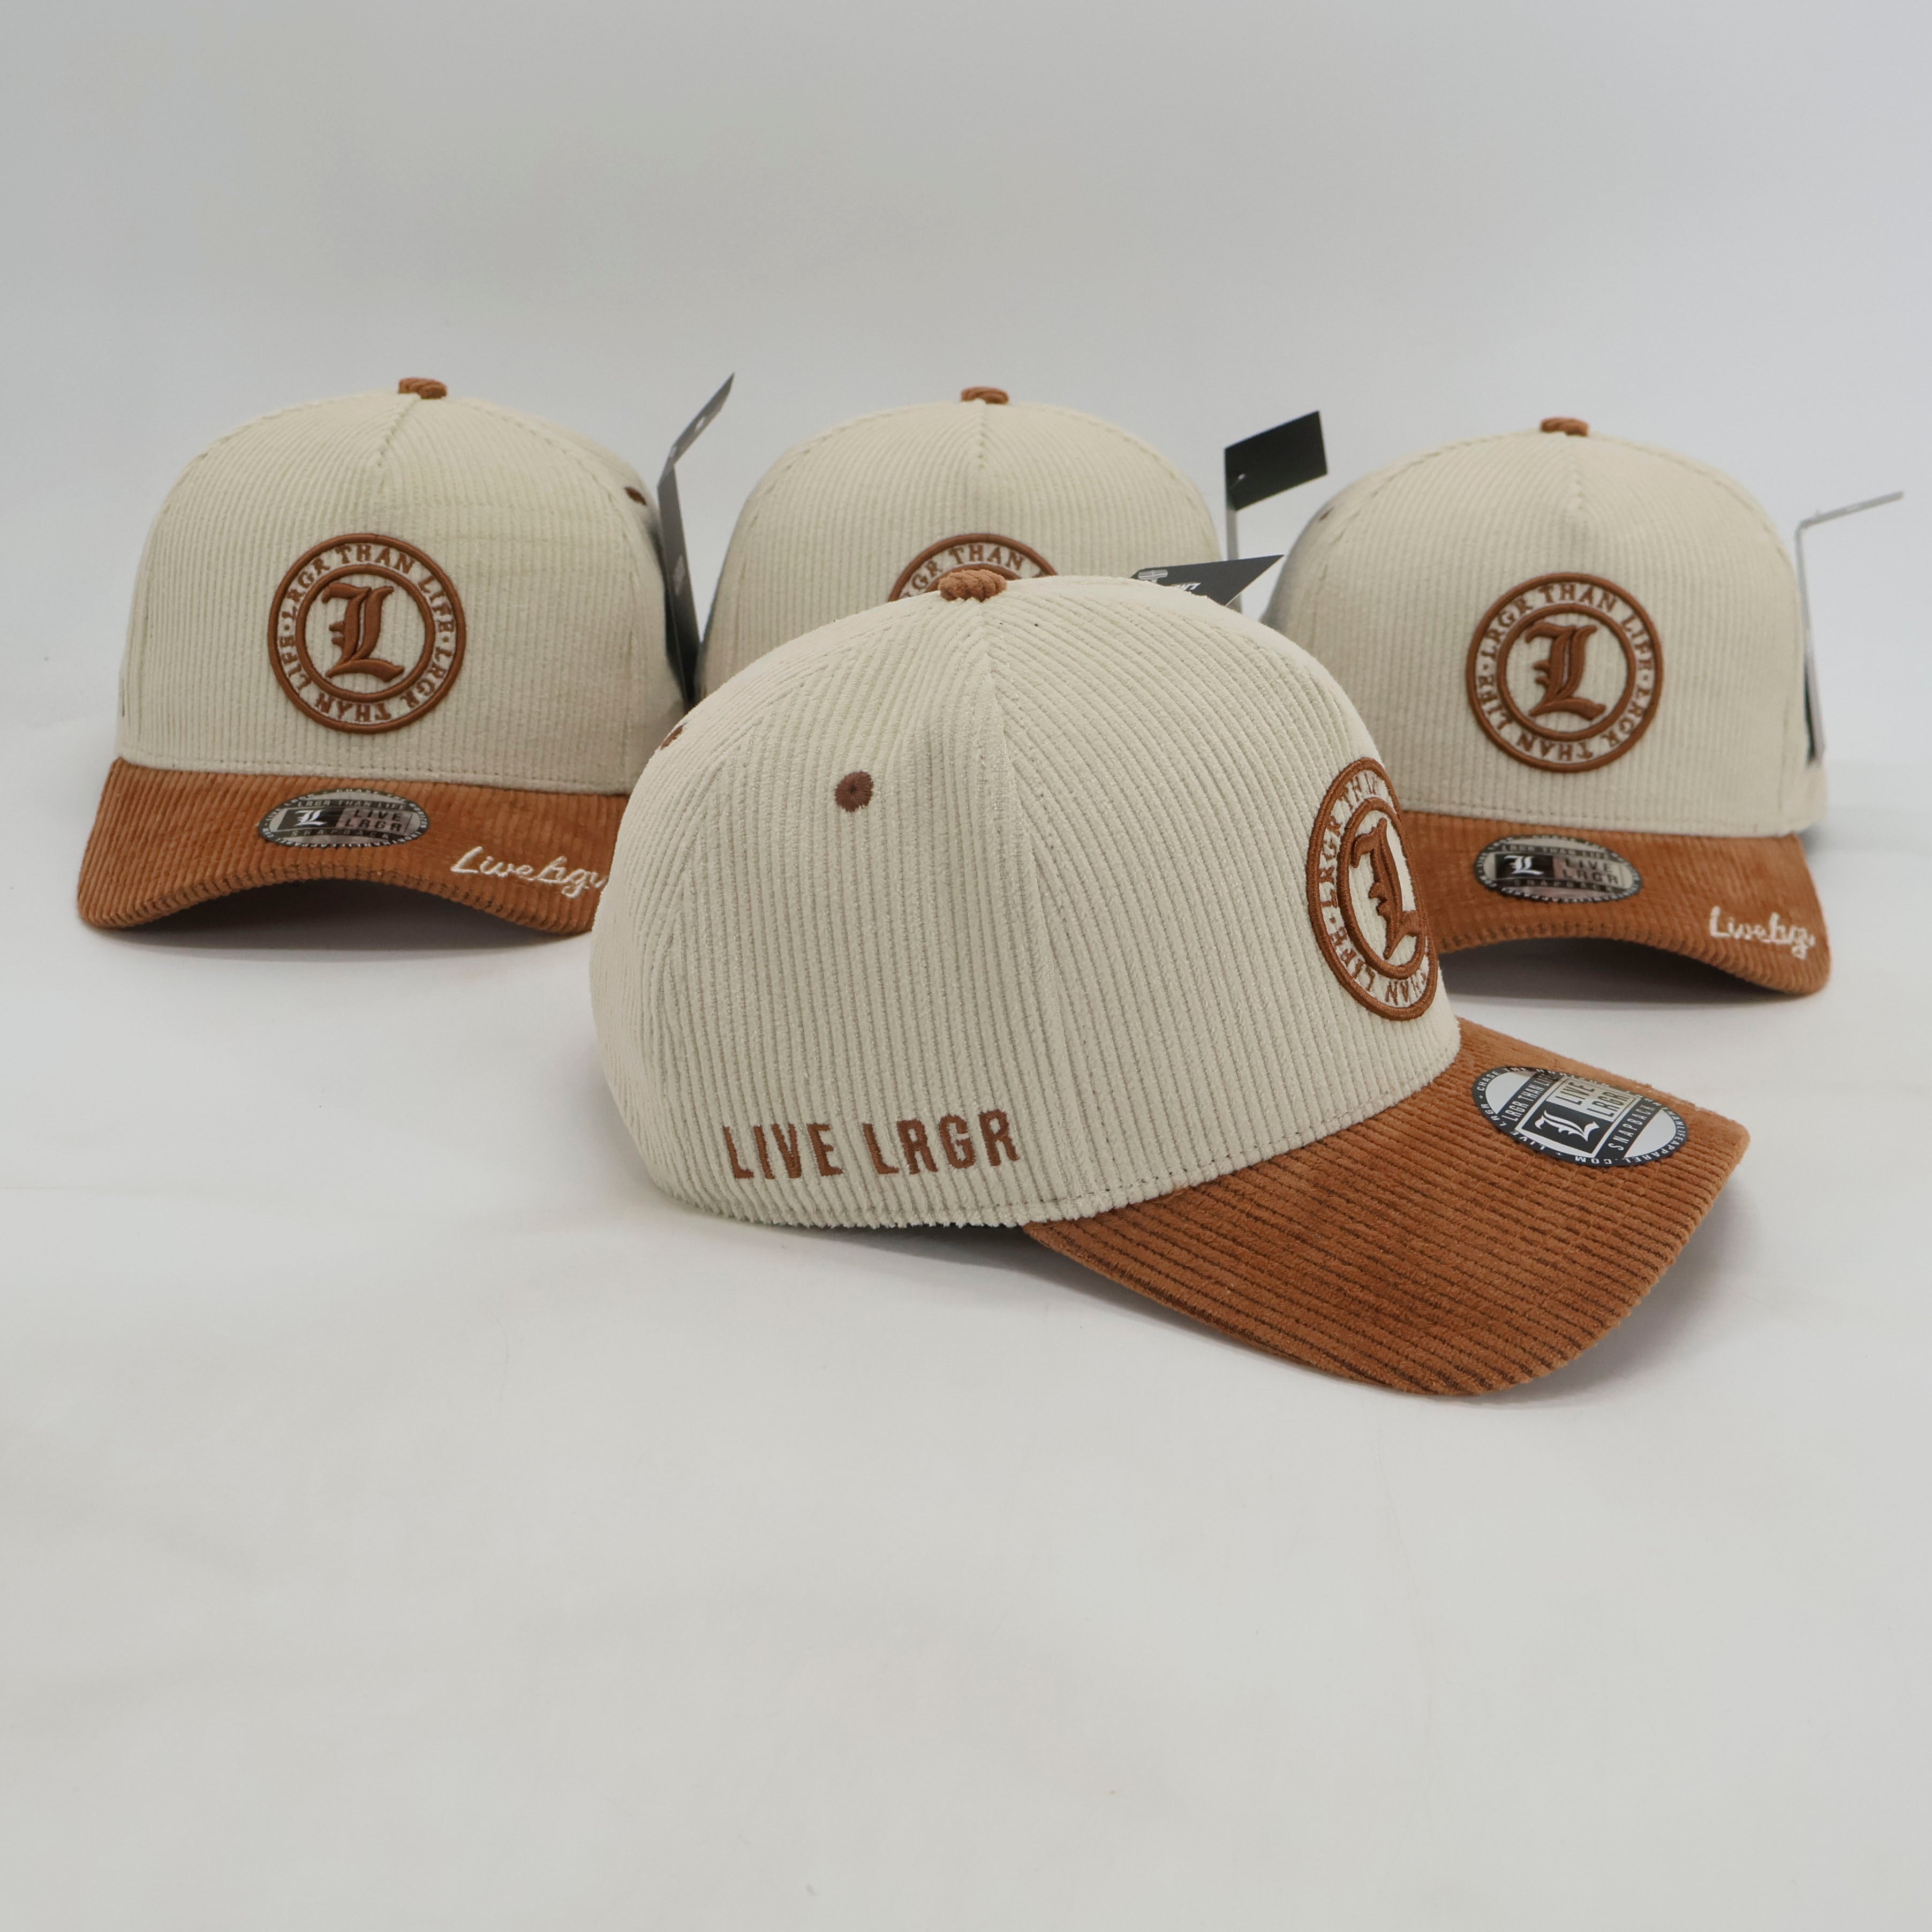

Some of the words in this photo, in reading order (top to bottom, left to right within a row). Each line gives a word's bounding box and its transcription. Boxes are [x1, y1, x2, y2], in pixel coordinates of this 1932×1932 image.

[948, 544, 1025, 571] THAN
[282, 556, 330, 620] LRGR
[336, 543, 416, 574] THAN
[417, 574, 455, 632] LIFE
[1480, 594, 1533, 658] LRGR
[1538, 582, 1618, 612] THAN
[1619, 614, 1654, 671] LIFE
[279, 636, 313, 691] LIFE
[399, 646, 452, 708] LRGR
[314, 692, 392, 722] THAN
[1478, 675, 1514, 731] LIFE
[1600, 687, 1650, 748] LRGR
[1516, 730, 1594, 761] THAN
[345, 818, 402, 832] LRGR
[353, 810, 402, 821] LIVE
[1476, 1070, 1501, 1091] CHASE
[1555, 1082, 1595, 1106] LIVE
[1480, 1103, 1507, 1127] LRGR
[1501, 1101, 1529, 1121] LRGR
[1518, 1083, 1545, 1101] THAN
[1587, 1091, 1631, 1118] LRGR
[1511, 1129, 1546, 1151] LIVE
[1608, 1104, 1656, 1151] SNAPBACK
[722, 1122, 844, 1180] LIVE
[862, 1109, 1020, 1175] LRGR
